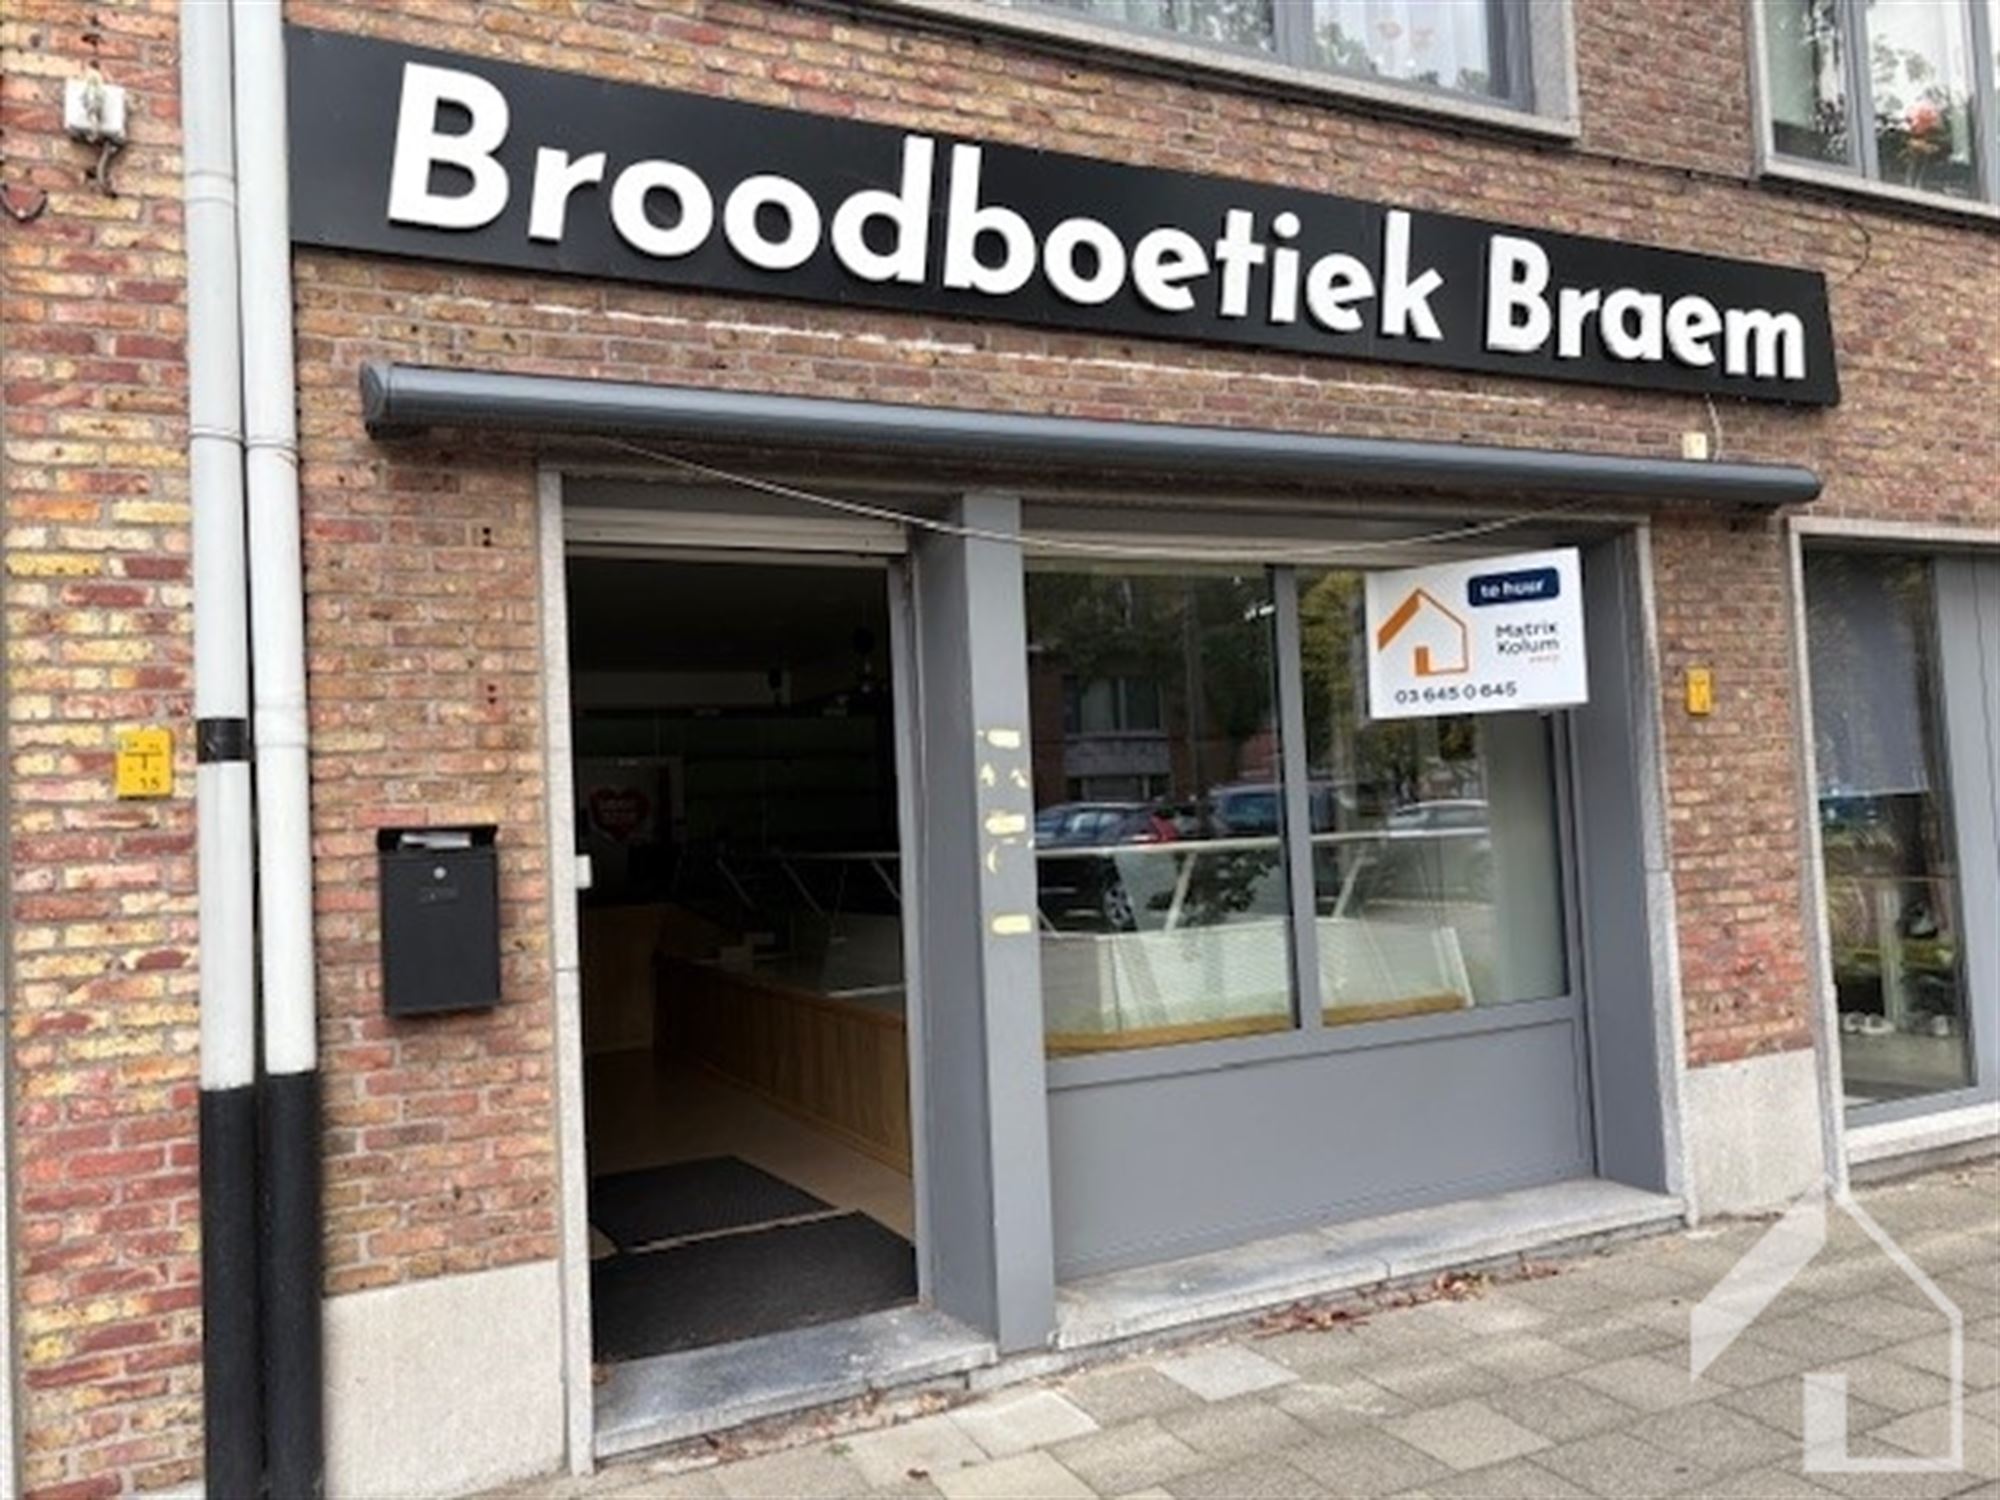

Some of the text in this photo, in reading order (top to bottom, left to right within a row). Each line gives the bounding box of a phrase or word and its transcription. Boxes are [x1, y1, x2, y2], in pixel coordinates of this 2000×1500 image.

[387, 61, 1806, 381] Broodboetiek Braem
[1480, 584, 1501, 599] te
[1495, 621, 1558, 638] Matrix
[1496, 638, 1560, 656] Kolum
[1395, 688, 1420, 704] 03
